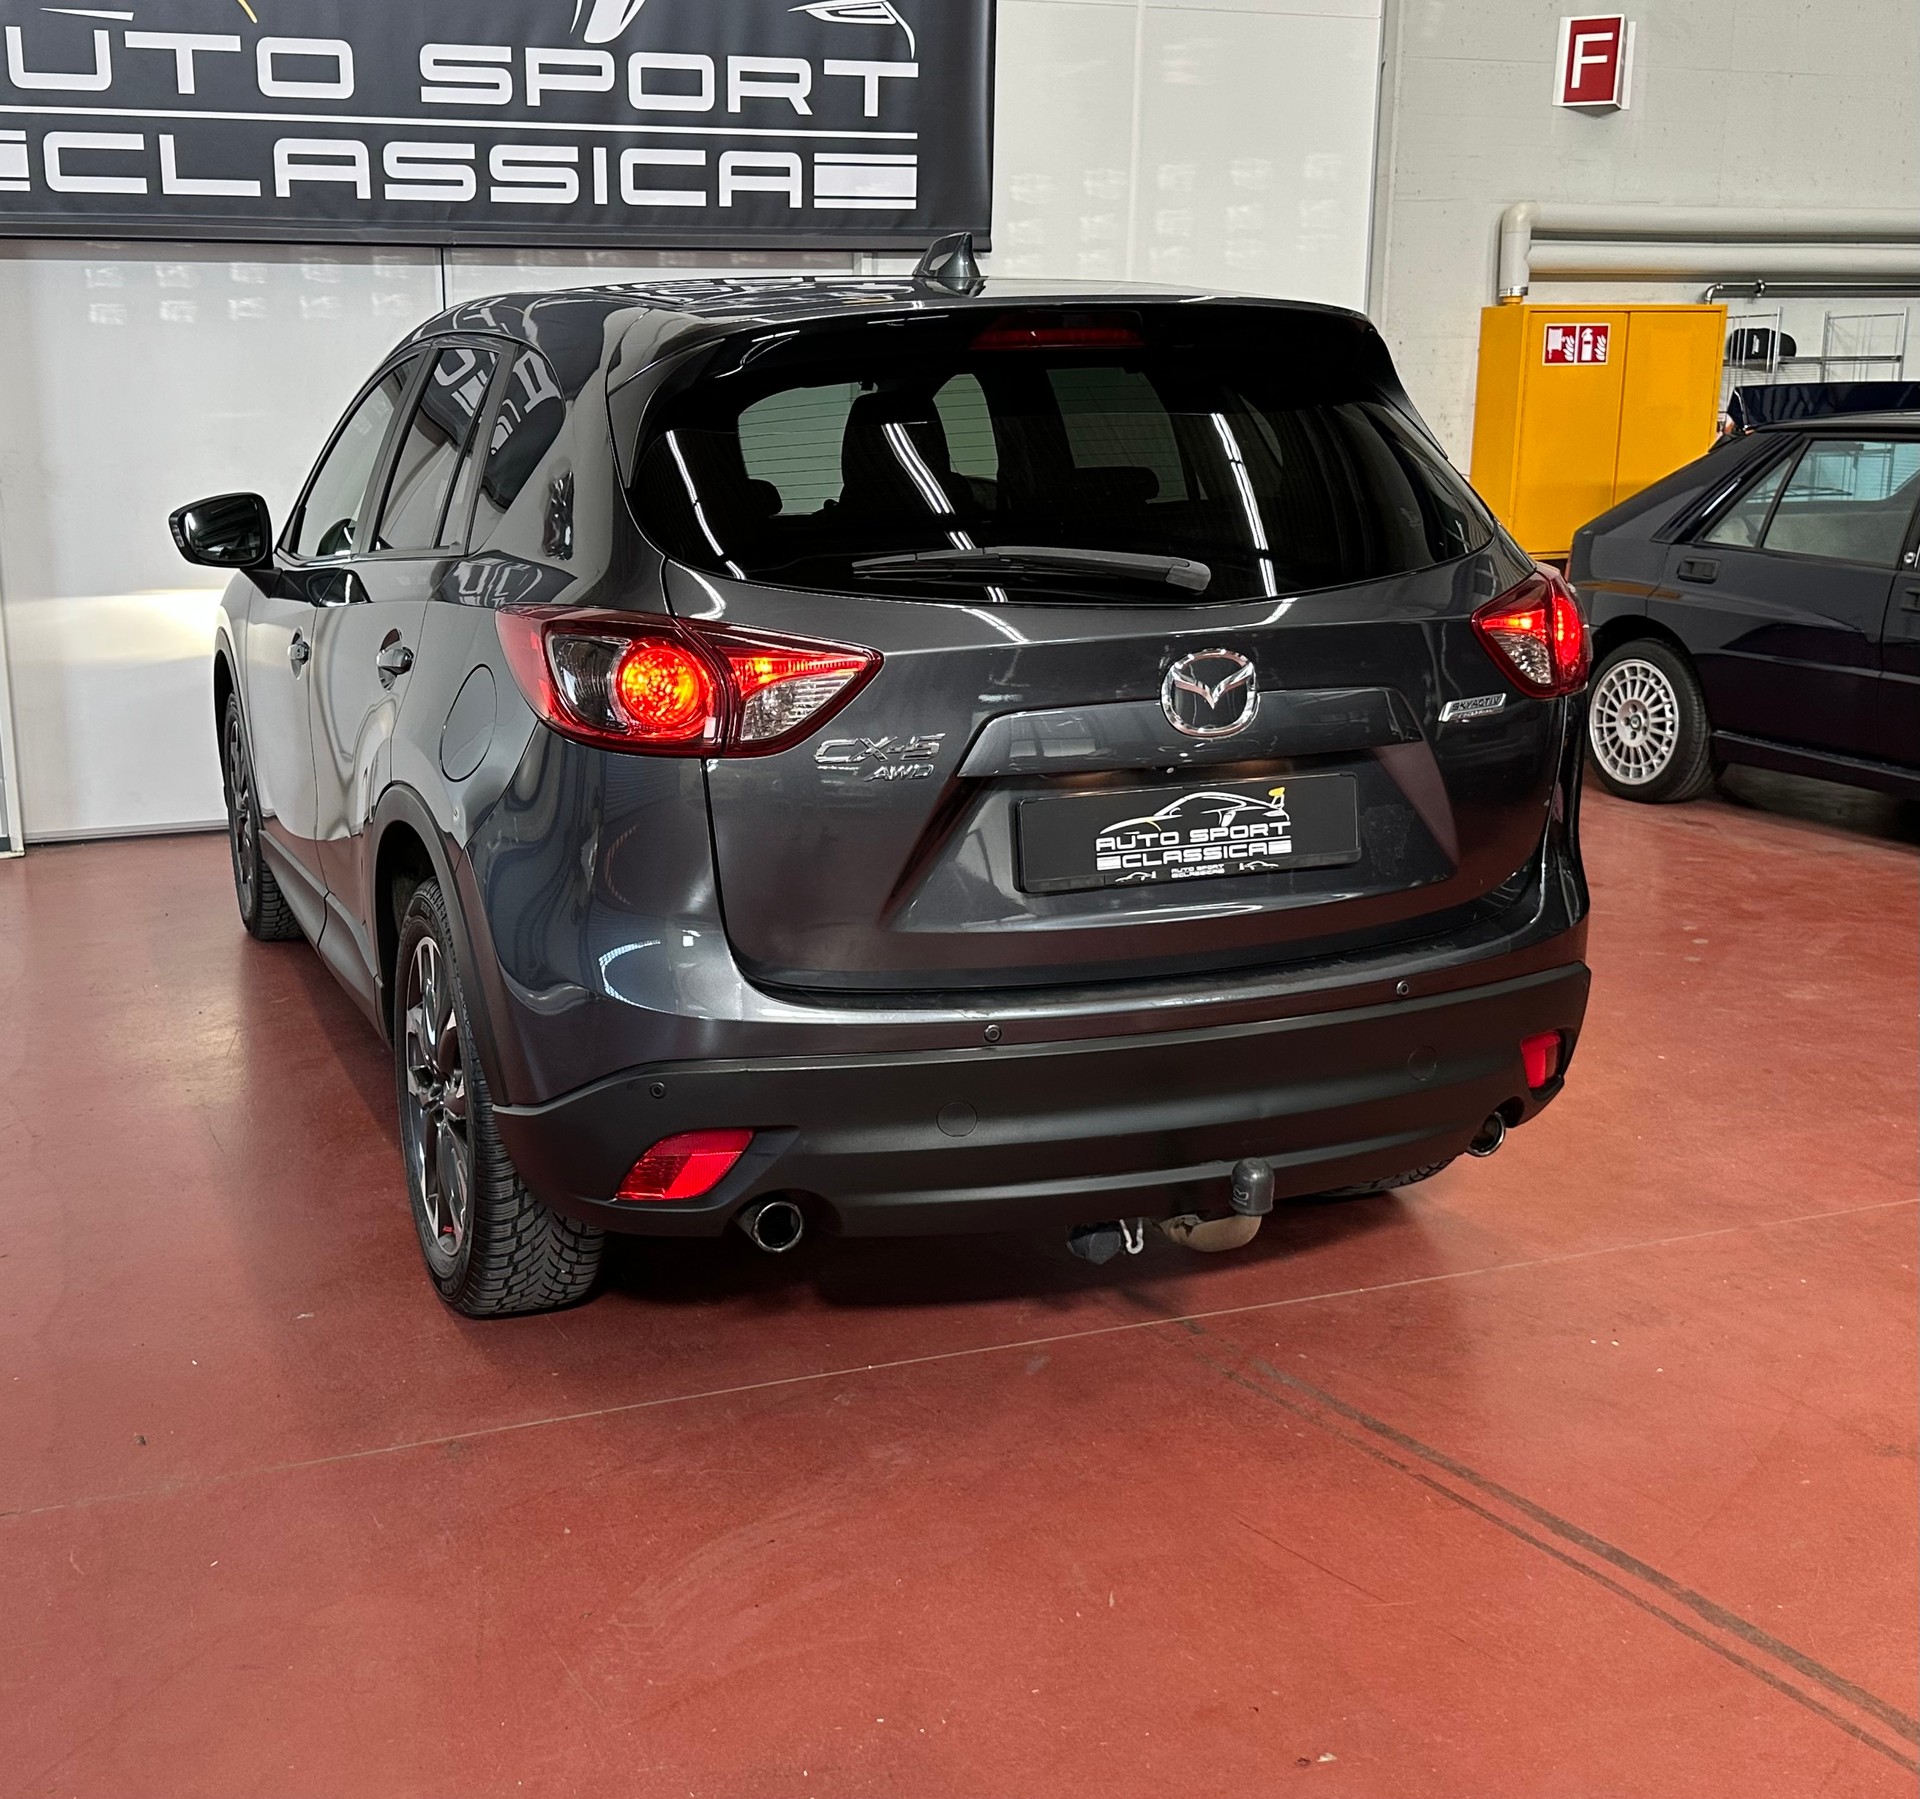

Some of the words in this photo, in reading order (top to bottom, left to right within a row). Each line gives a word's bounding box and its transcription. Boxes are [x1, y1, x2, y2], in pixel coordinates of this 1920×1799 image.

[1571, 32, 1613, 89] F
[419, 44, 918, 117] SPORT
[43, 131, 803, 208] CLASSICA
[814, 733, 946, 764] CX-5
[864, 764, 934, 782] AWD
[1096, 831, 1180, 851] AUTO
[1189, 821, 1291, 843] SPORT
[1122, 842, 1268, 868] CLASSICA
